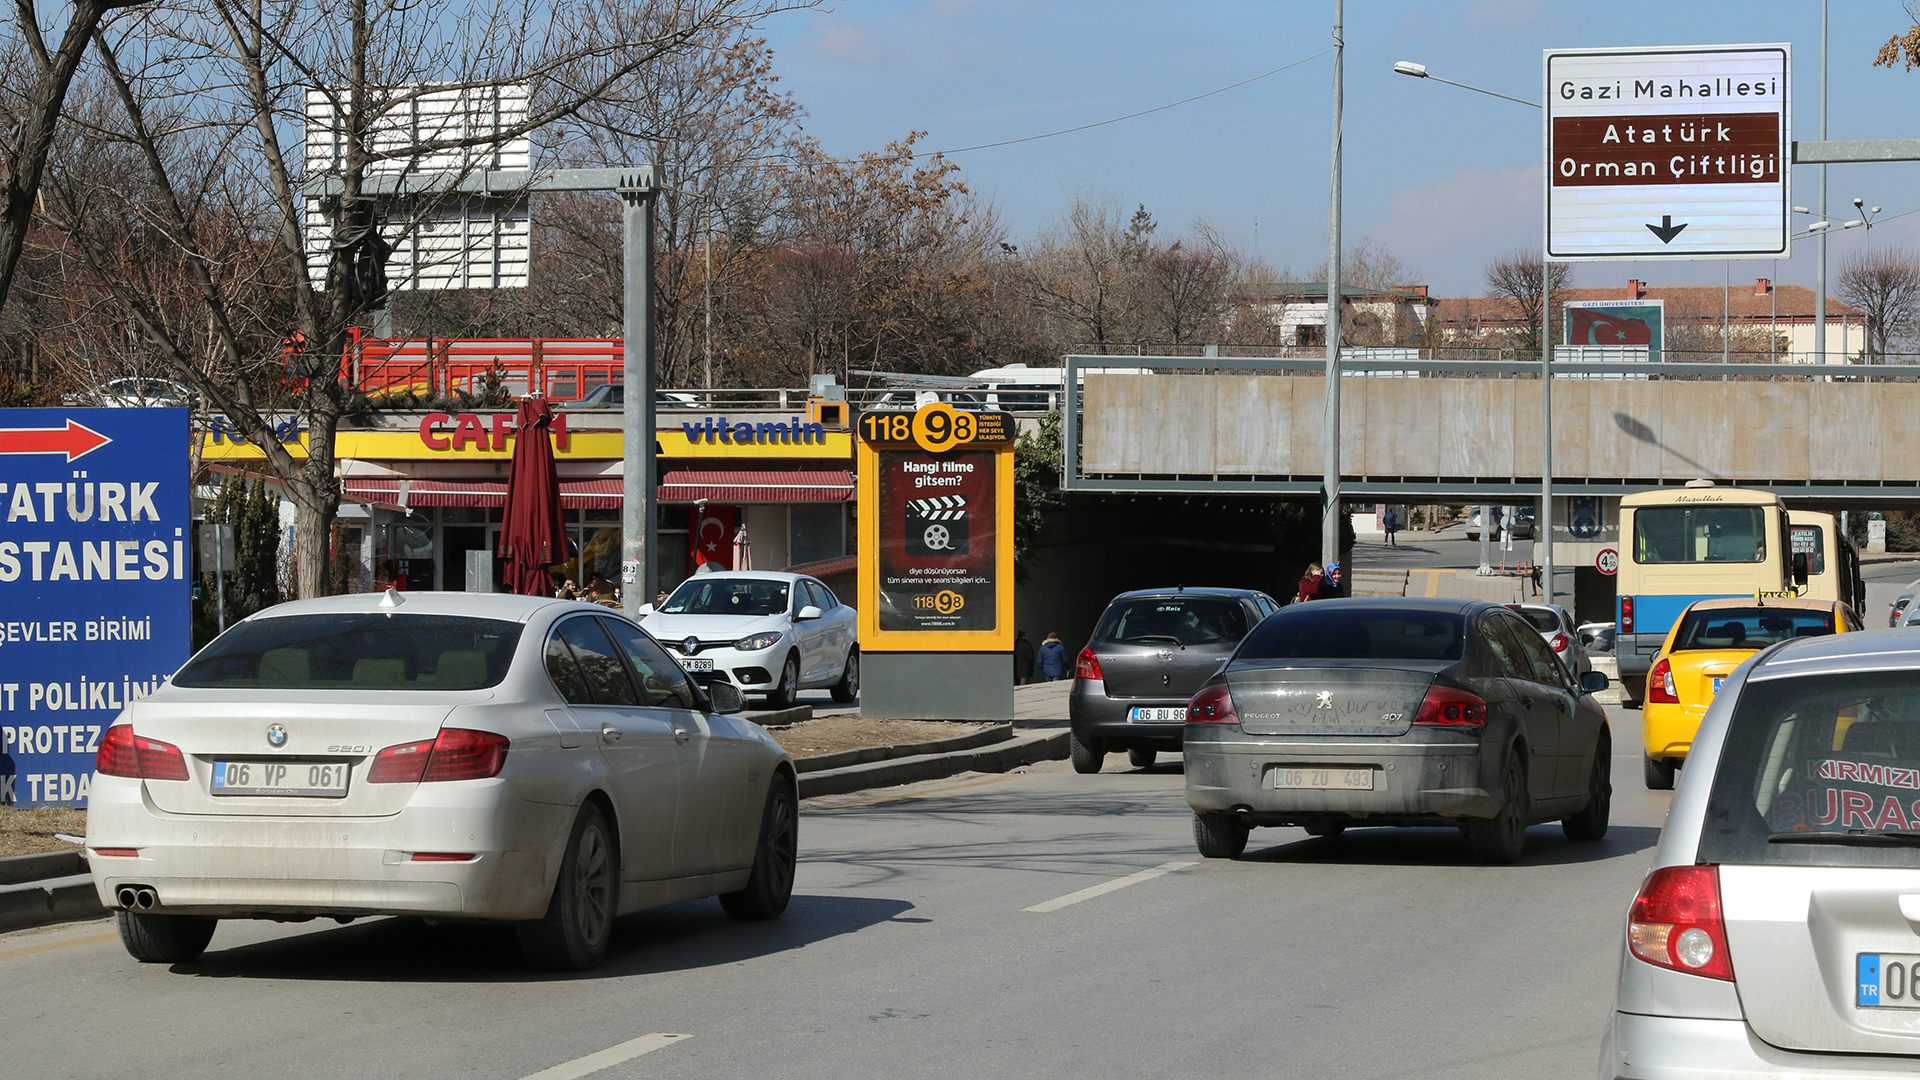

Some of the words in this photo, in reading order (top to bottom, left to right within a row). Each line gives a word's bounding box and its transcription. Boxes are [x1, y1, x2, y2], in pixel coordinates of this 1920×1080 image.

[1560, 81, 1621, 100] Gazi
[1634, 77, 1776, 99] Mahallesi
[1602, 122, 1731, 144] Atatürk
[1560, 157, 1657, 177] Orman
[1669, 153, 1775, 179] Çiftliği
[682, 416, 823, 442] vitamin
[903, 461, 940, 474] Hangi
[942, 461, 975, 473] filme
[915, 475, 963, 488] gitsem?
[0, 470, 161, 523] ATÜRK
[85, 615, 151, 642] BİRİMİ
[694, 660, 712, 669] 8289
[1140, 709, 1151, 719] 06
[1157, 709, 1169, 719] BU
[1173, 709, 1188, 719] 96
[1382, 713, 1403, 721] 407
[2, 725, 101, 754] PROTEZ
[226, 763, 251, 786] 06
[264, 764, 287, 786] VP
[308, 765, 343, 787] 061
[1285, 770, 1302, 786] 06
[1311, 770, 1328, 786] ZU
[1344, 770, 1370, 787] 493
[1807, 759, 1920, 790] KIRMIZI
[1860, 984, 1878, 996] TR
